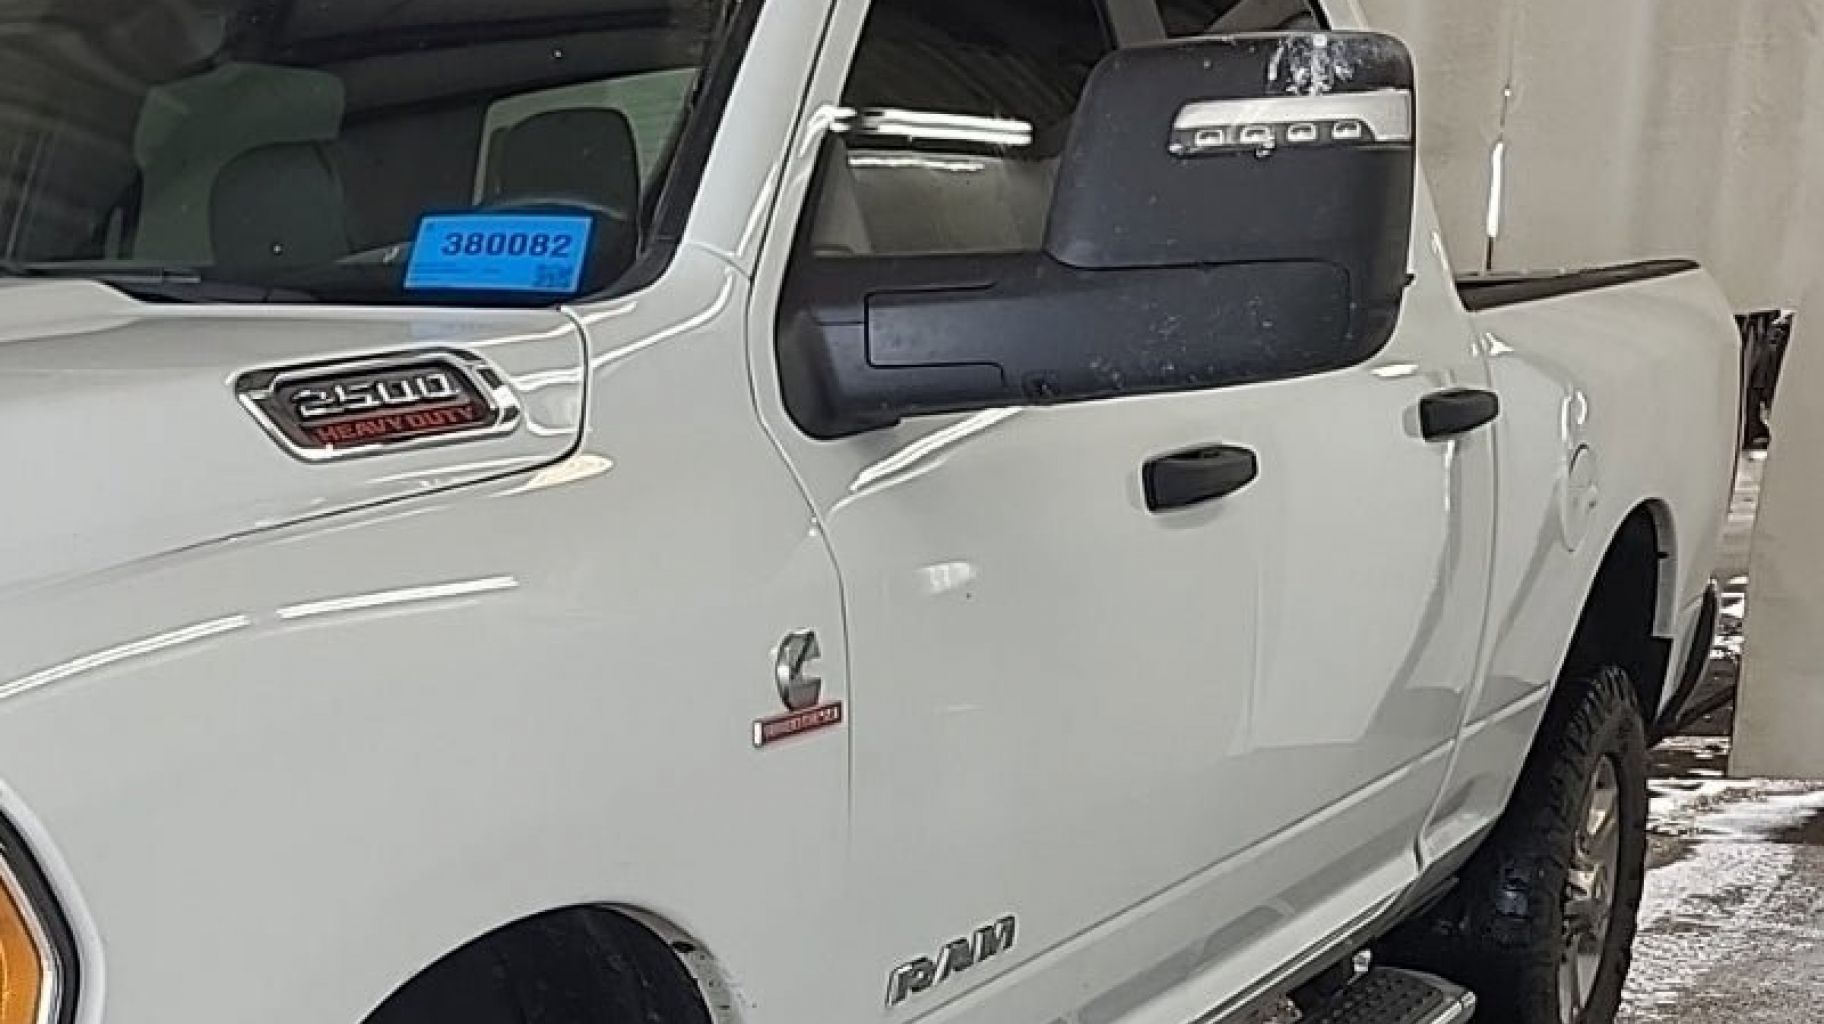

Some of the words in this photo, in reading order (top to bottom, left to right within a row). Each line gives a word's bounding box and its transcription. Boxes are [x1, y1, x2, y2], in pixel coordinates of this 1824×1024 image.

[441, 232, 572, 258] 380082
[291, 374, 460, 417] 2500
[315, 413, 405, 442] HEAVY
[407, 405, 474, 427] DUTY
[885, 915, 1016, 1007] RAM
